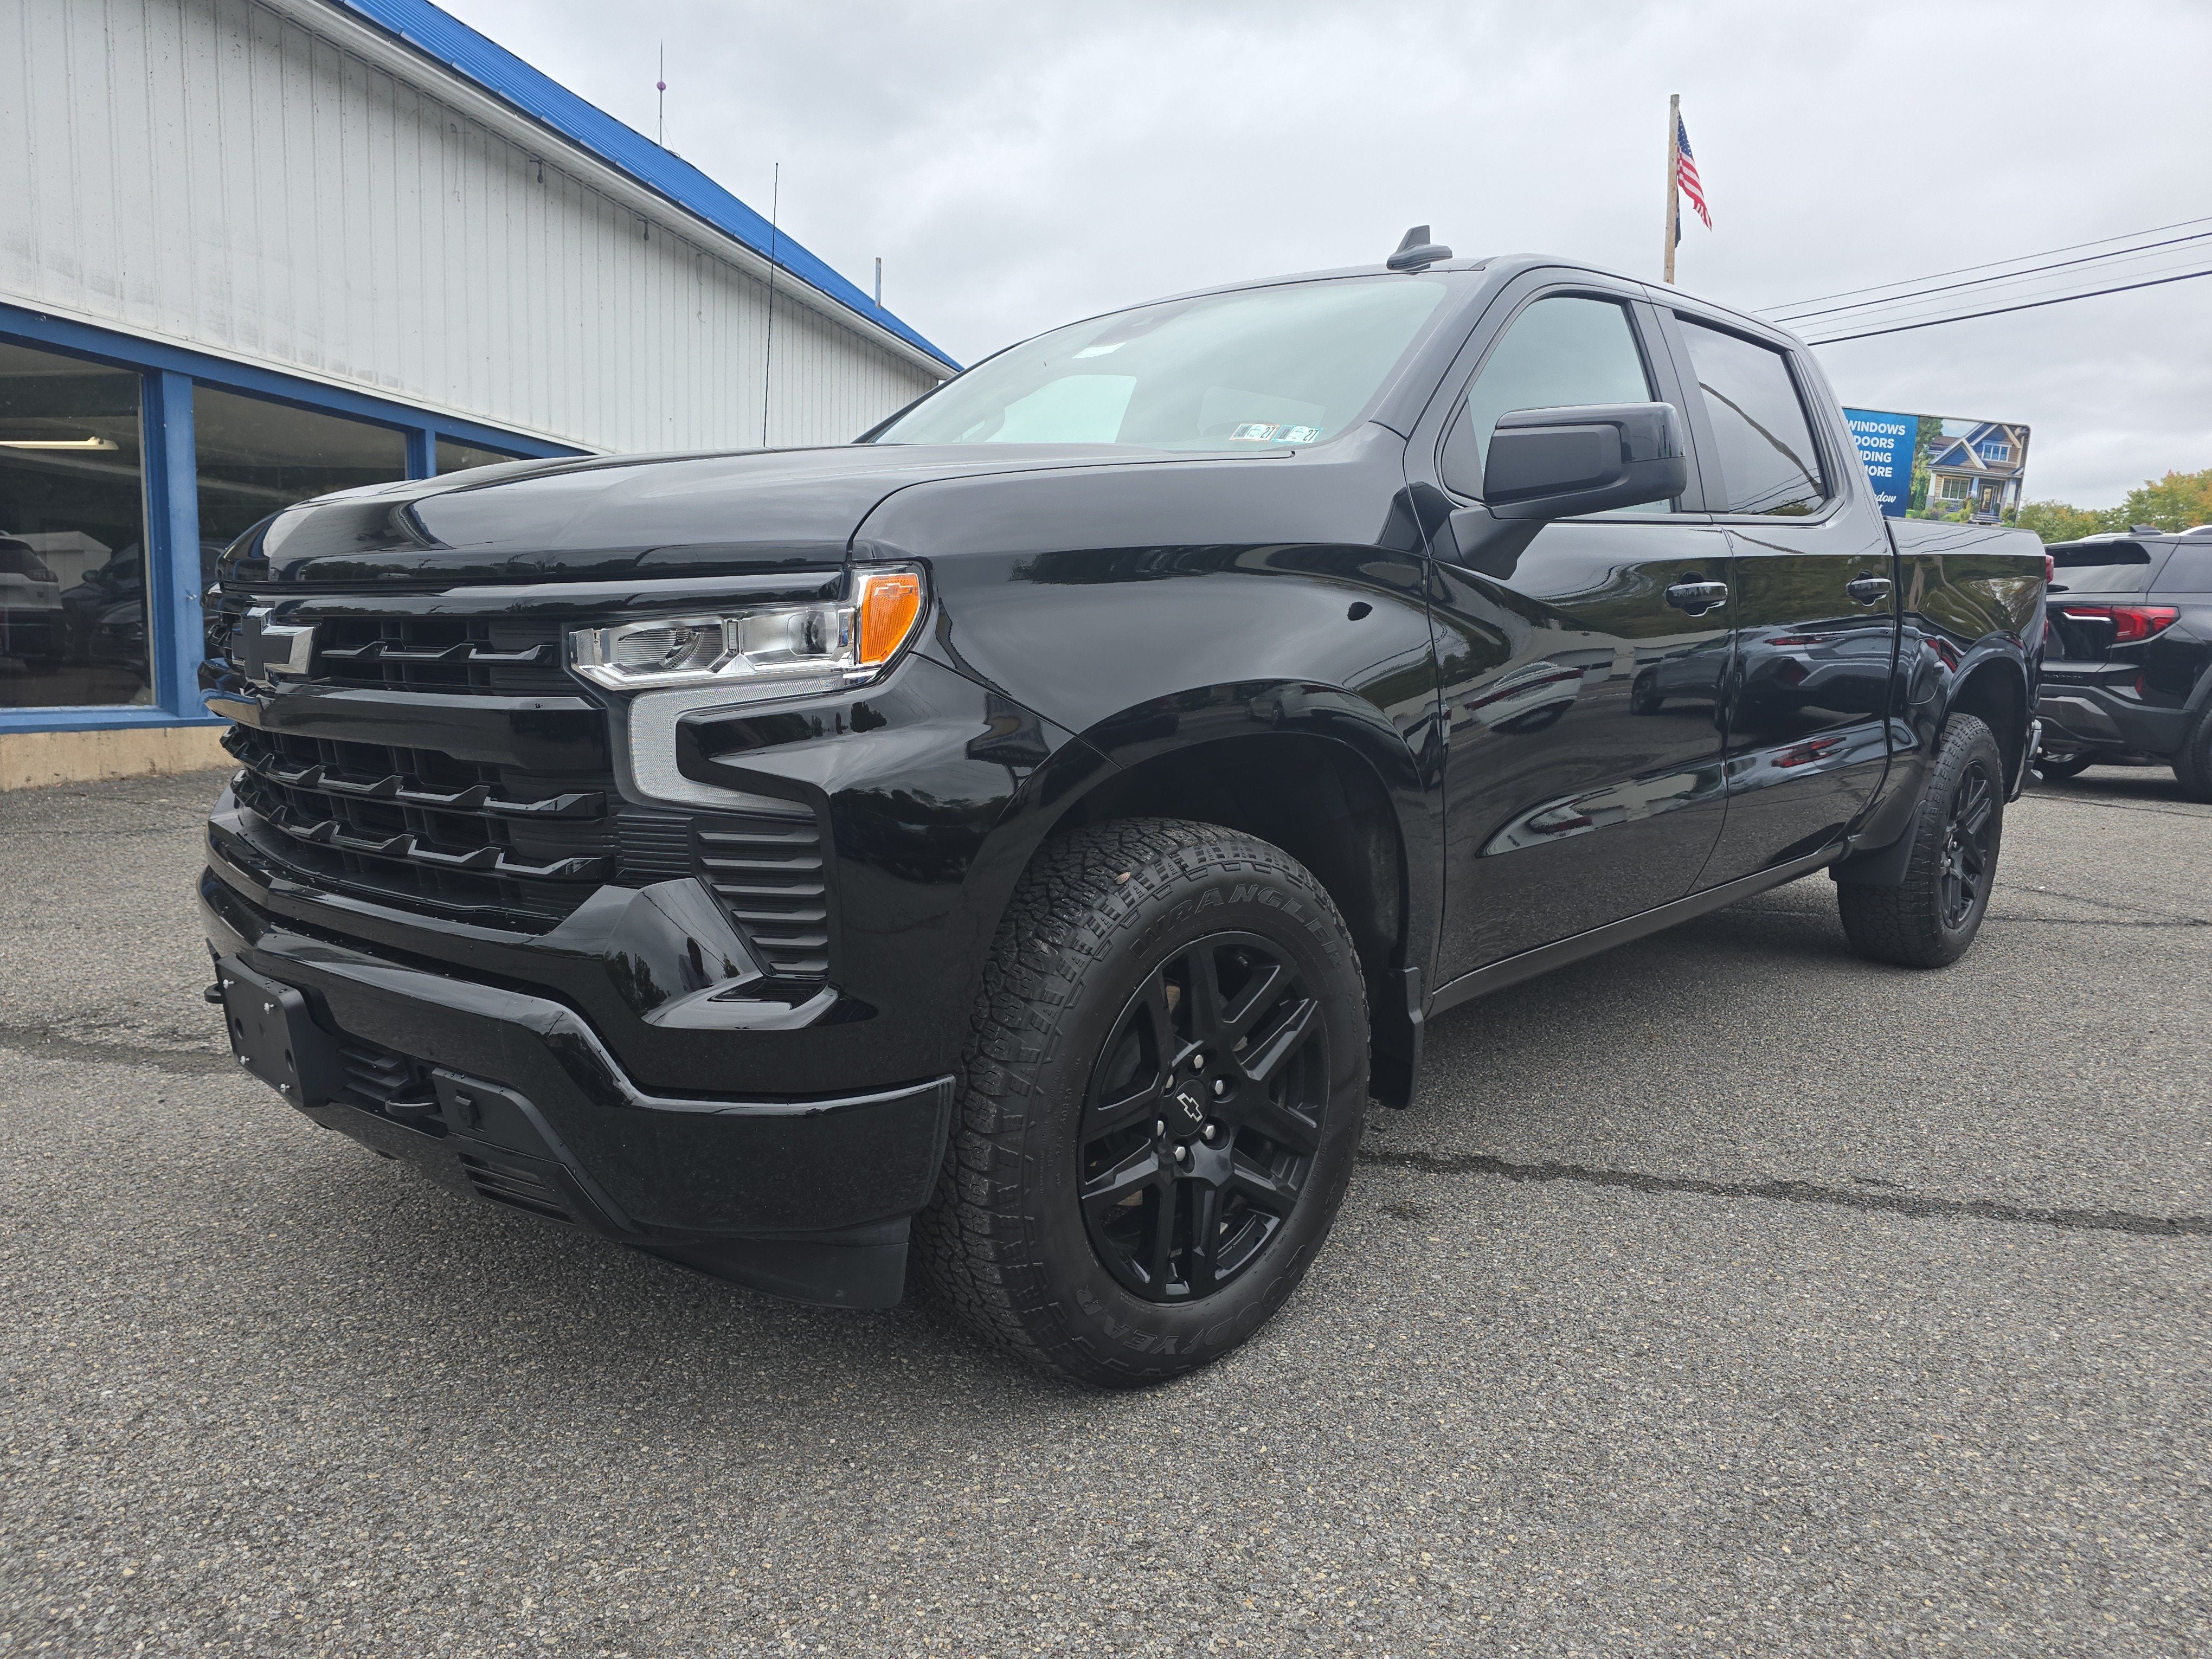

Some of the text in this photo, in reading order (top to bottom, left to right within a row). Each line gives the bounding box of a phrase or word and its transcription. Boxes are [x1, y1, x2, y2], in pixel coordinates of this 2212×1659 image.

[1260, 427, 1276, 439] 27
[1848, 420, 1906, 435] WINDOWS
[1303, 429, 1319, 442] 27
[1854, 435, 1895, 449] DOORS
[1860, 450, 1892, 463] IDING
[1875, 491, 1896, 503] dow
[1129, 884, 1342, 968] WRANGLER
[1076, 1244, 1307, 1355] GOODYEAR
